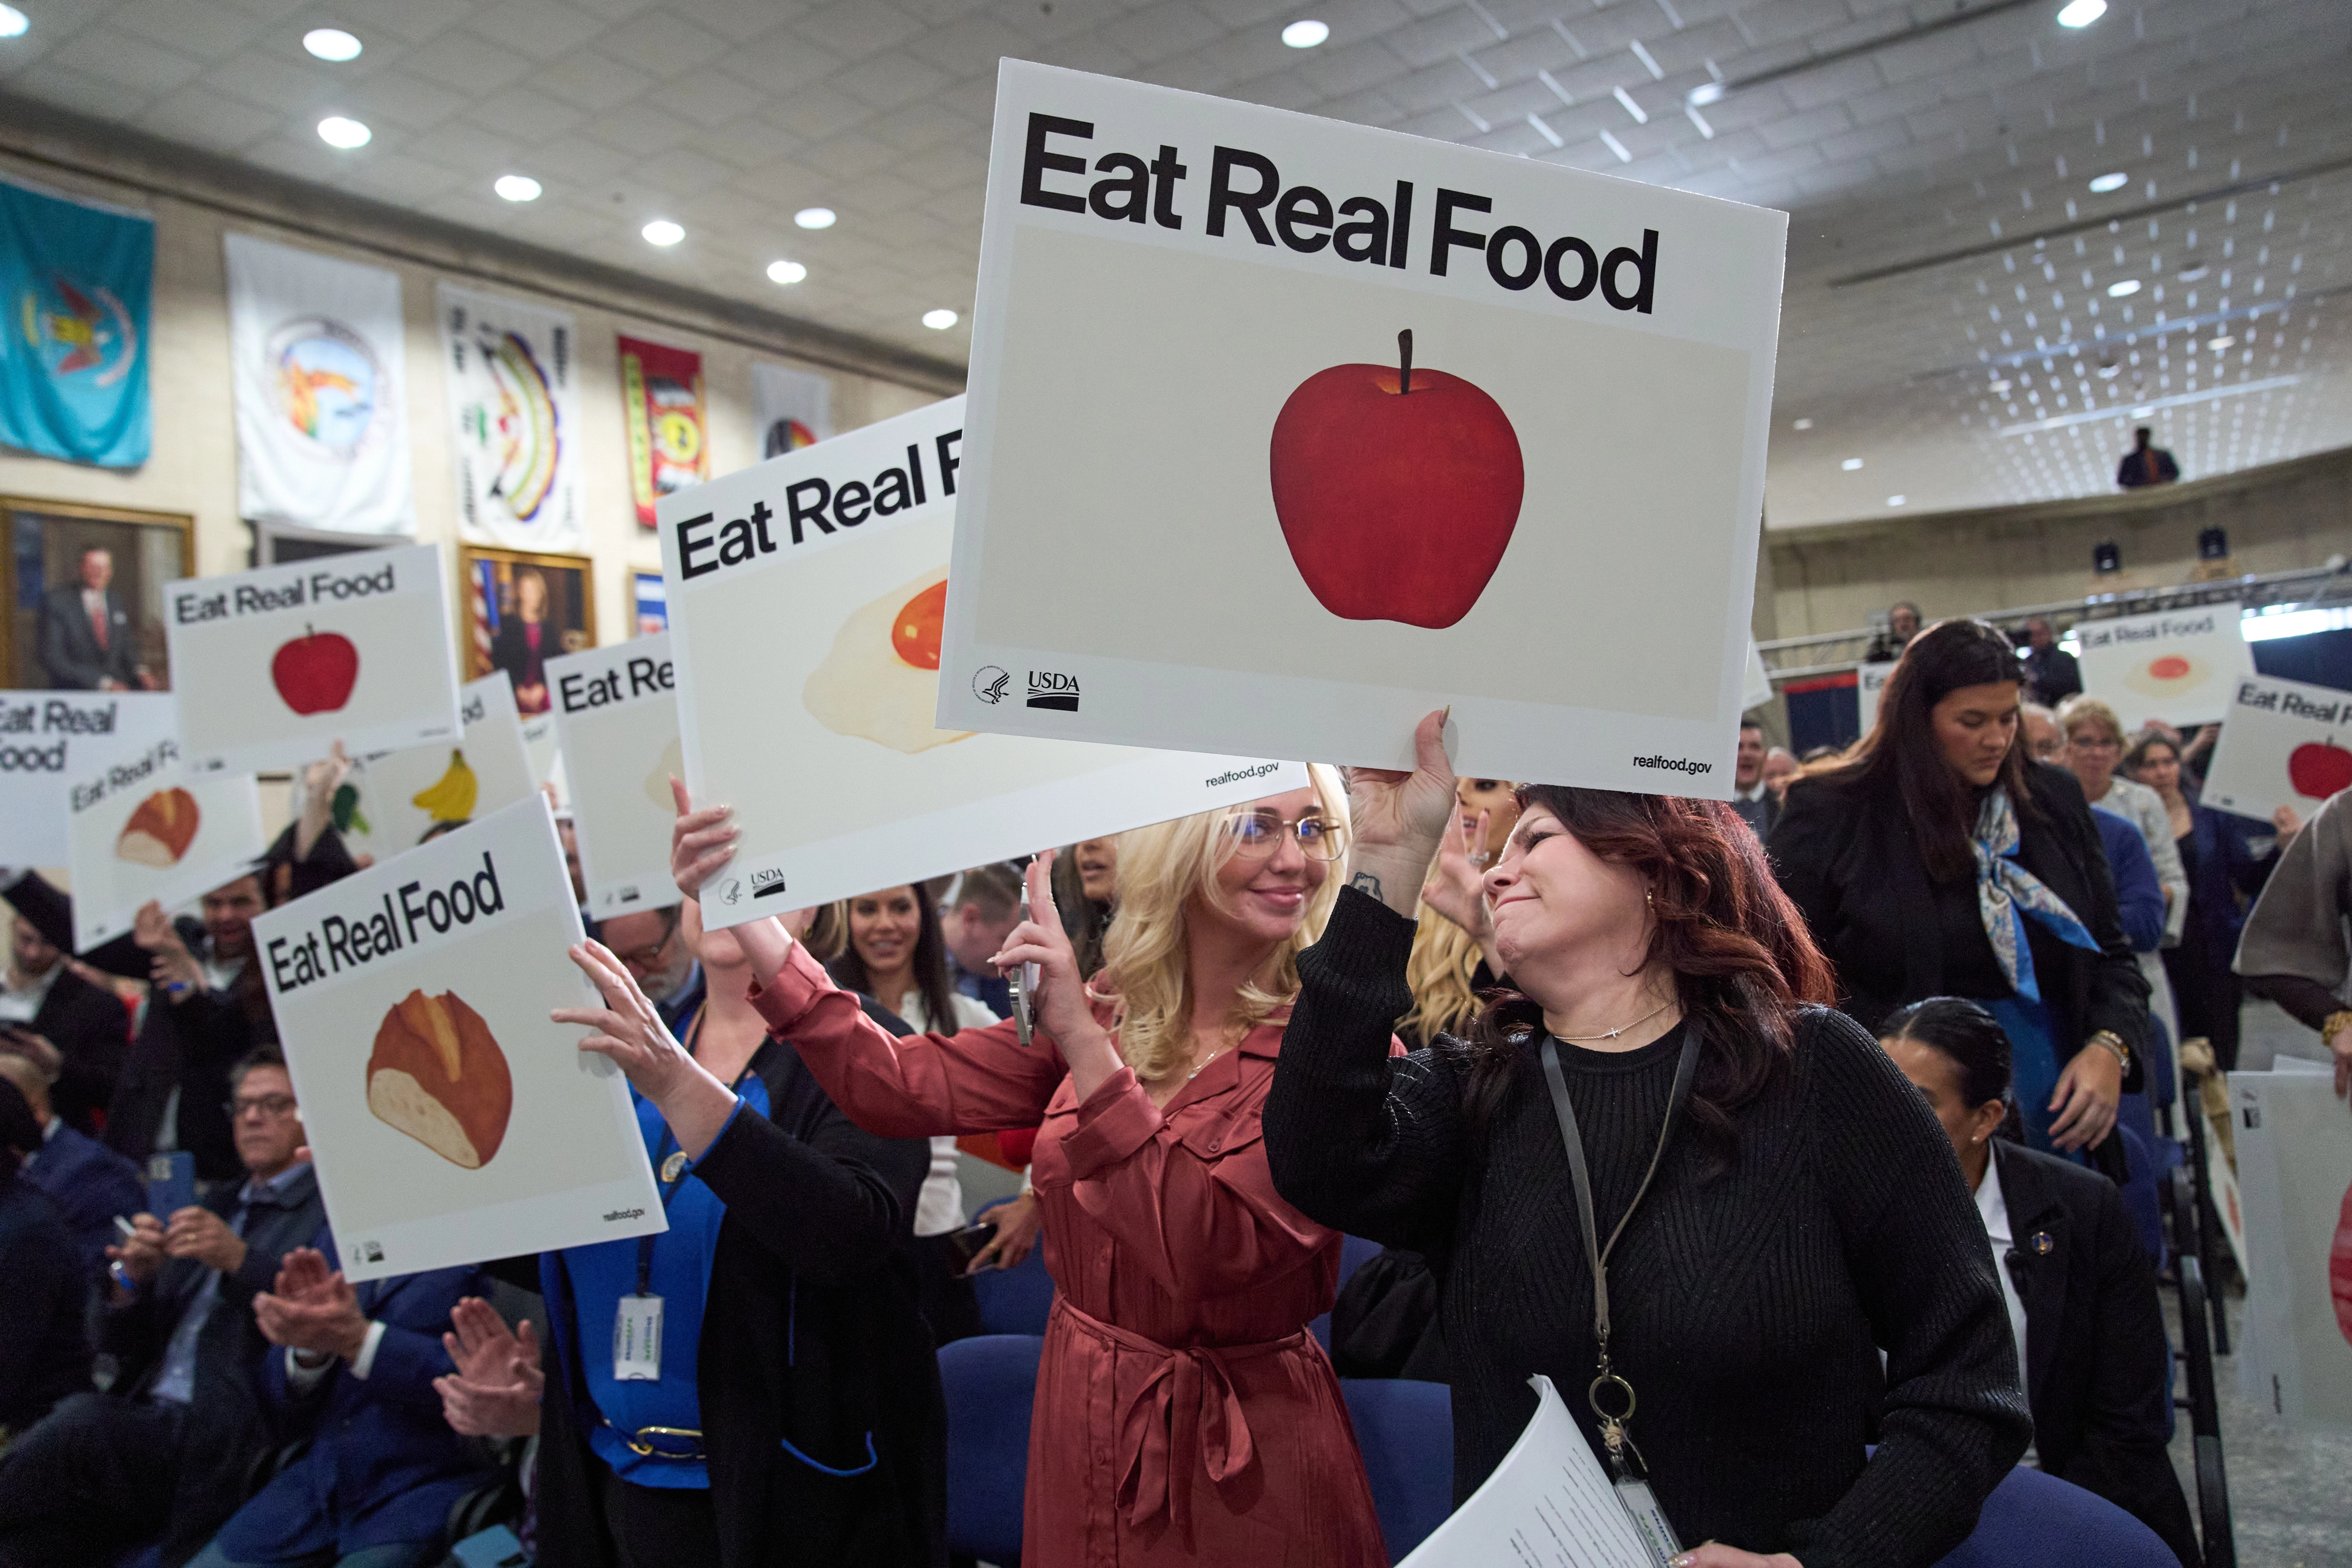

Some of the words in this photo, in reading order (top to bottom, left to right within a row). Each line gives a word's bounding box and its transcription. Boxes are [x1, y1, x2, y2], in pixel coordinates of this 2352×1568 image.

[1020, 112, 1187, 230] Eat
[1206, 145, 1414, 270] Real
[1429, 187, 1659, 315] Food
[677, 502, 777, 581] Eat
[786, 443, 927, 545] Real
[175, 591, 229, 624] Eat
[235, 577, 306, 614] Real
[310, 563, 395, 603] Food
[2080, 628, 2112, 648] Eat
[560, 668, 624, 714] Eat
[628, 656, 675, 697] Re
[1028, 671, 1080, 692] USDA
[42, 699, 117, 735] Real
[2237, 683, 2278, 709] Eat
[2281, 691, 2339, 723] Real
[0, 739, 68, 772] ood
[1633, 755, 1712, 775] realfood.gov
[1205, 762, 1279, 788] realfood.gov
[751, 867, 784, 885] USDA
[268, 931, 326, 994] Eat
[322, 893, 403, 973] Real
[397, 851, 505, 944] Food
